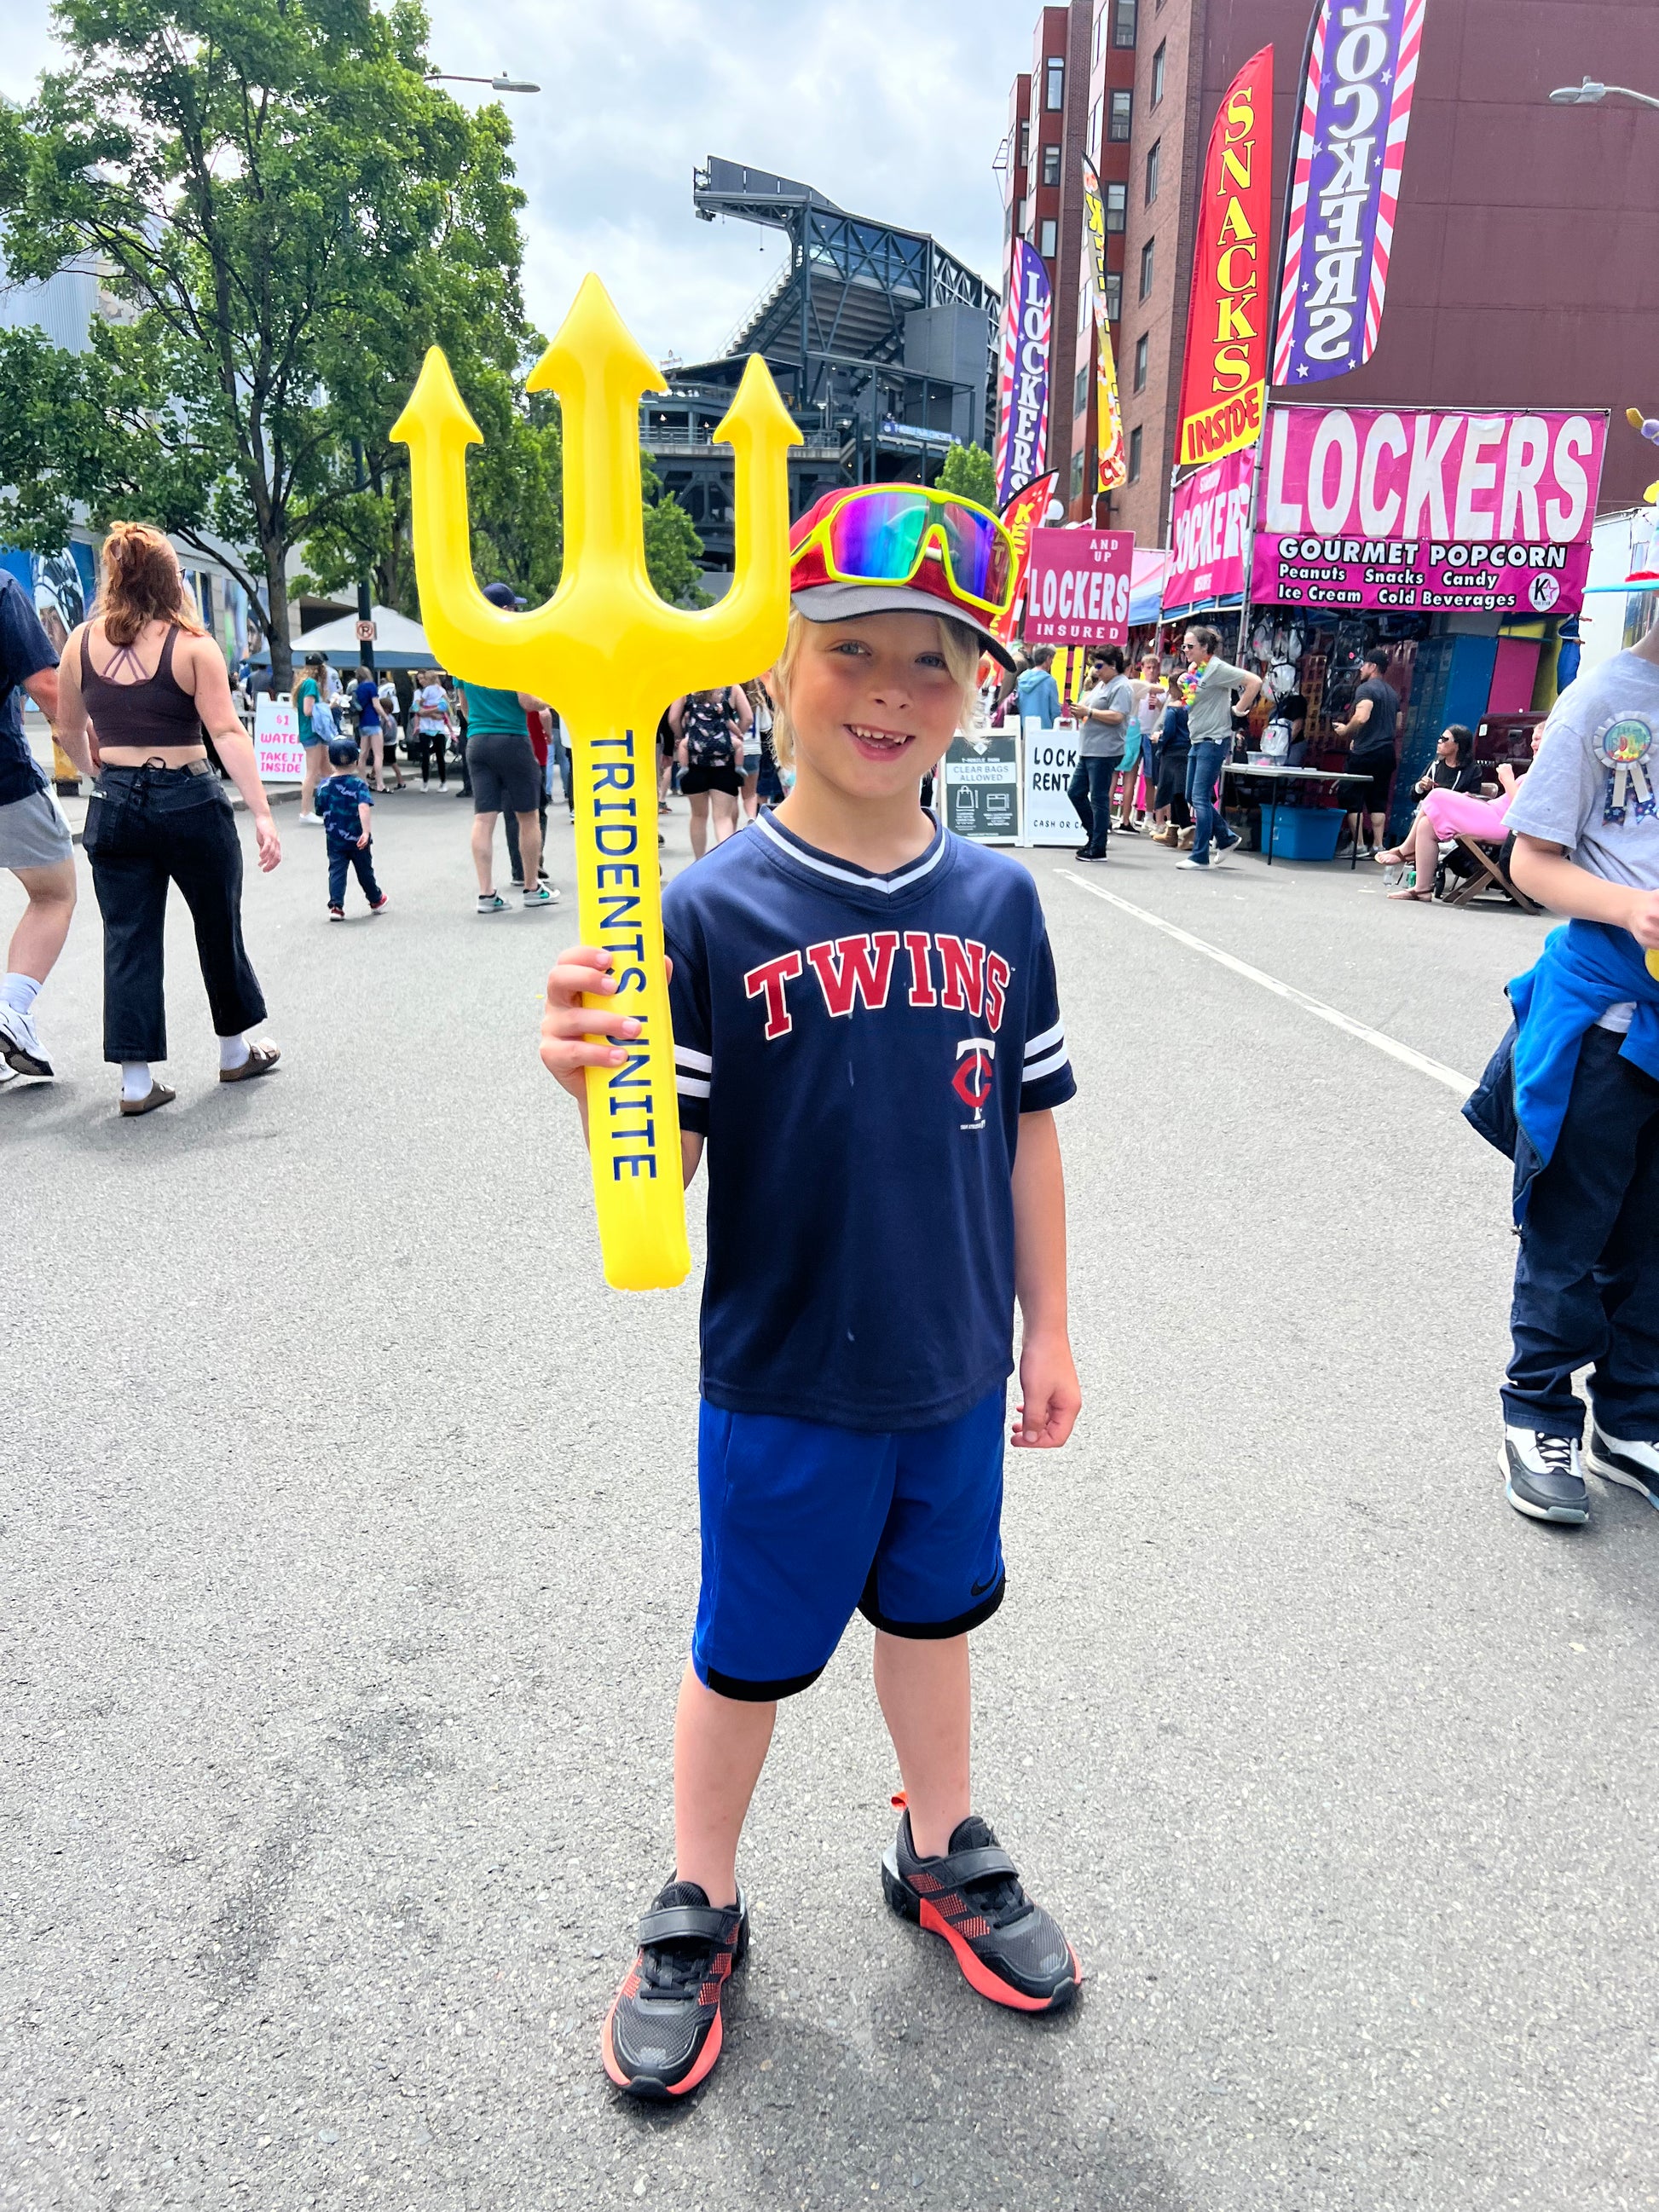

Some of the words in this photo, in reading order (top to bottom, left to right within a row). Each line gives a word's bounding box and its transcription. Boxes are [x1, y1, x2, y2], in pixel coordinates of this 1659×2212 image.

[1211, 86, 1257, 393] SNACKS
[1188, 387, 1259, 461] INSIDE
[1264, 409, 1593, 543] LOCKERS
[1090, 539, 1119, 551] AND
[1094, 551, 1112, 563] UP
[1279, 537, 1420, 566] GOURMET
[1429, 543, 1567, 569] POPCORN
[1279, 564, 1346, 582] Peanuts
[1364, 568, 1424, 586] Snacks
[1442, 571, 1498, 590] Candy
[1029, 569, 1130, 623] LOCKERS
[1279, 584, 1302, 600] Ice
[1309, 586, 1362, 603] Cream
[1379, 588, 1415, 606] Cold
[1422, 590, 1517, 611] Beverages
[1037, 623, 1119, 640] INSURED
[276, 714, 289, 725] $1
[260, 752, 289, 762] TAKE
[292, 754, 303, 762] IT
[260, 762, 301, 773] INSIDE
[953, 765, 983, 774] CLEAR
[1033, 819, 1055, 828] CASH
[590, 730, 647, 993] TRIDENTS
[743, 930, 1011, 1041] TWINS
